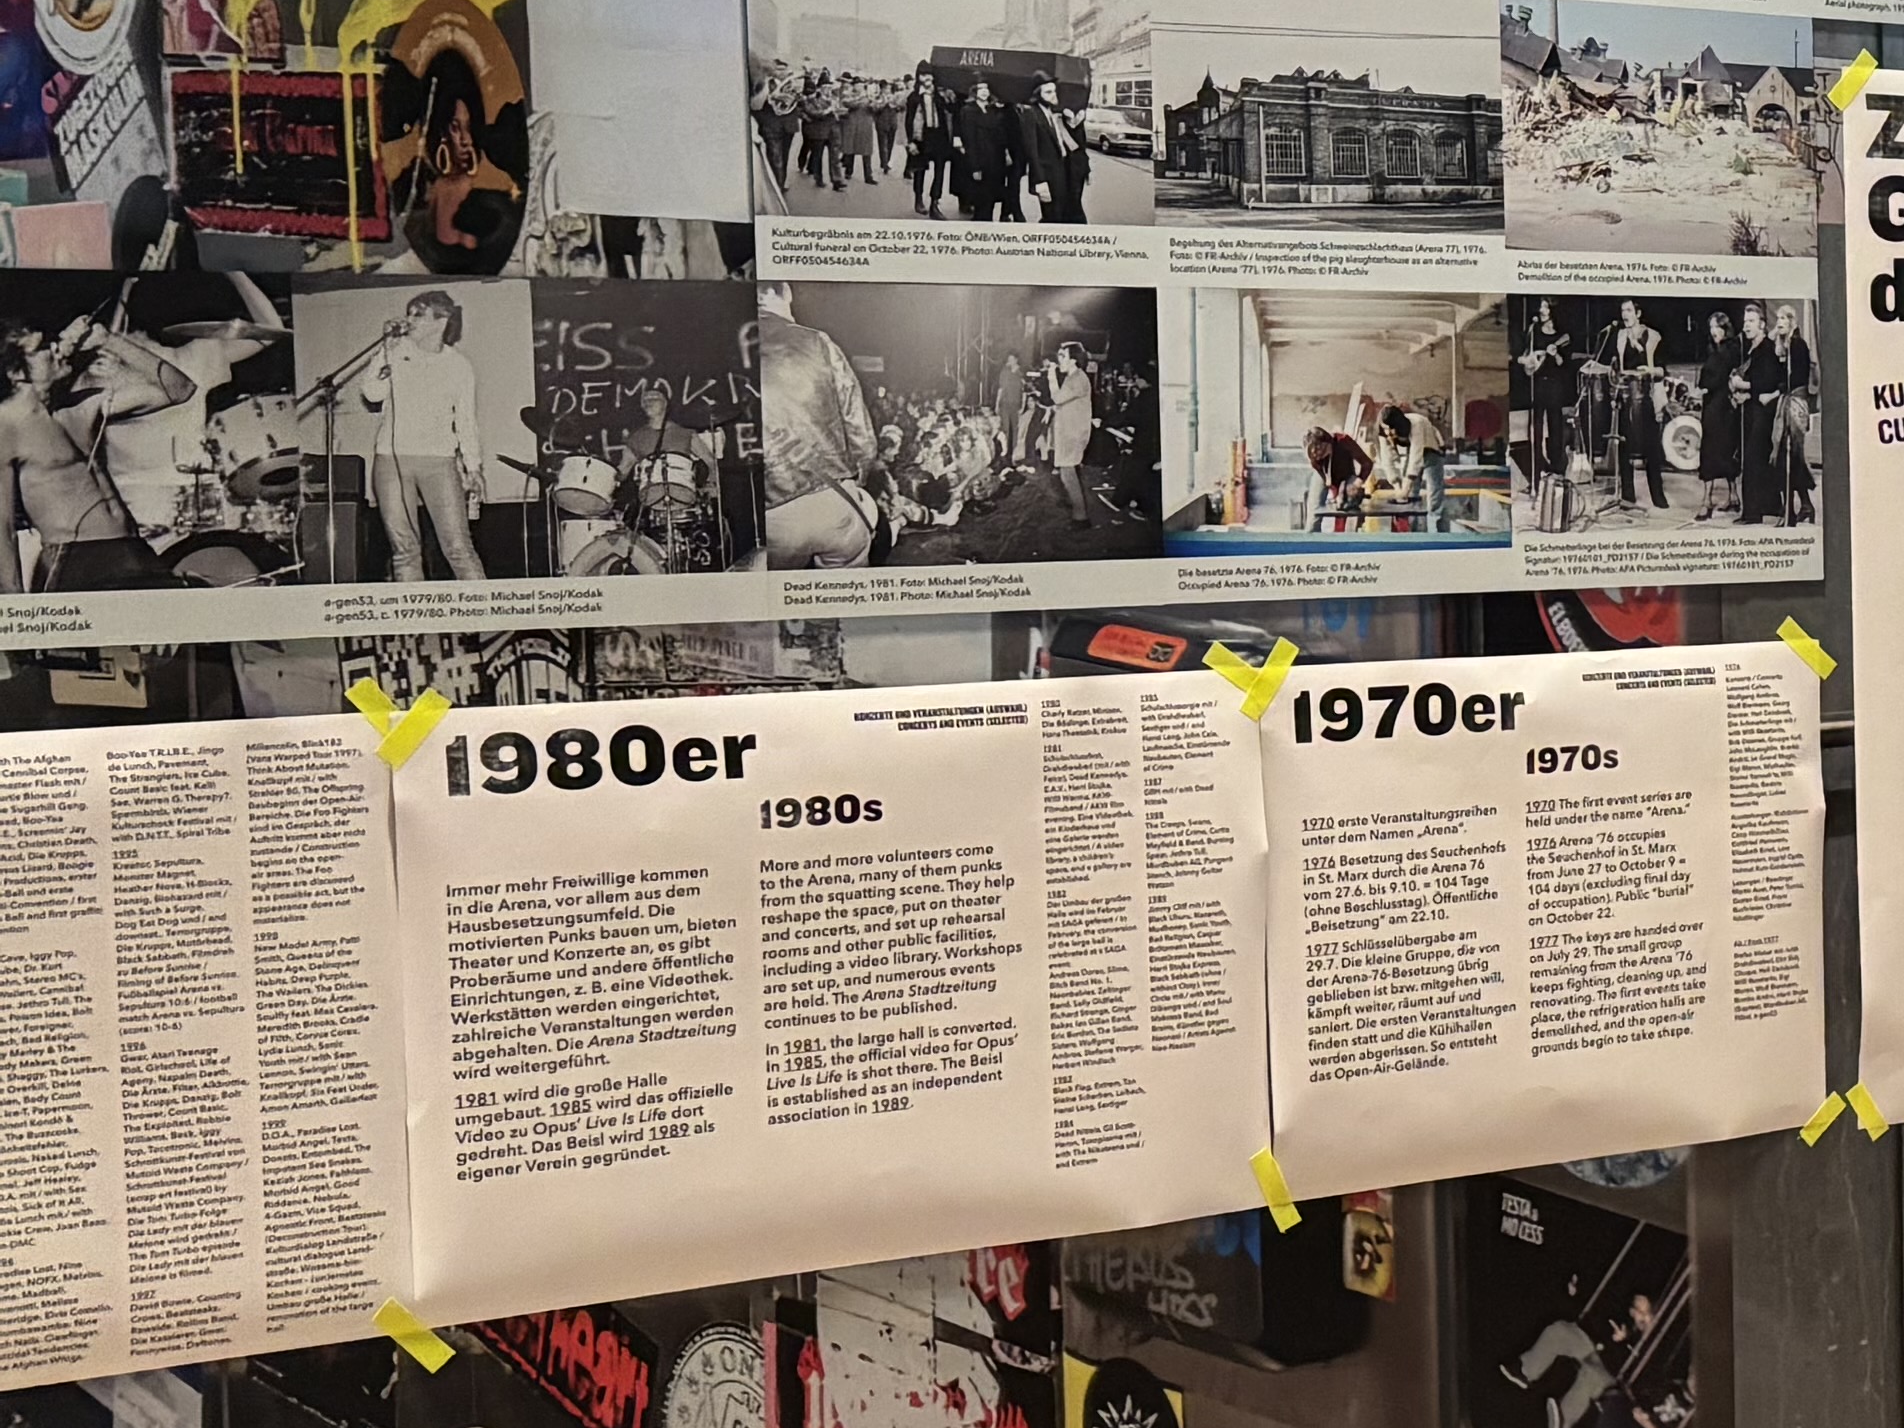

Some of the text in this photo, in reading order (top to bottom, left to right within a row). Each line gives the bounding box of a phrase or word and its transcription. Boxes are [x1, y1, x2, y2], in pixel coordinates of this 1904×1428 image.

[1293, 682, 1525, 744] 1970er
[445, 724, 757, 797] 1980er
[1526, 744, 1619, 775] 1970s
[760, 793, 883, 830] 1980s
[446, 867, 709, 898] Immer mehr Freiwillige kommen
